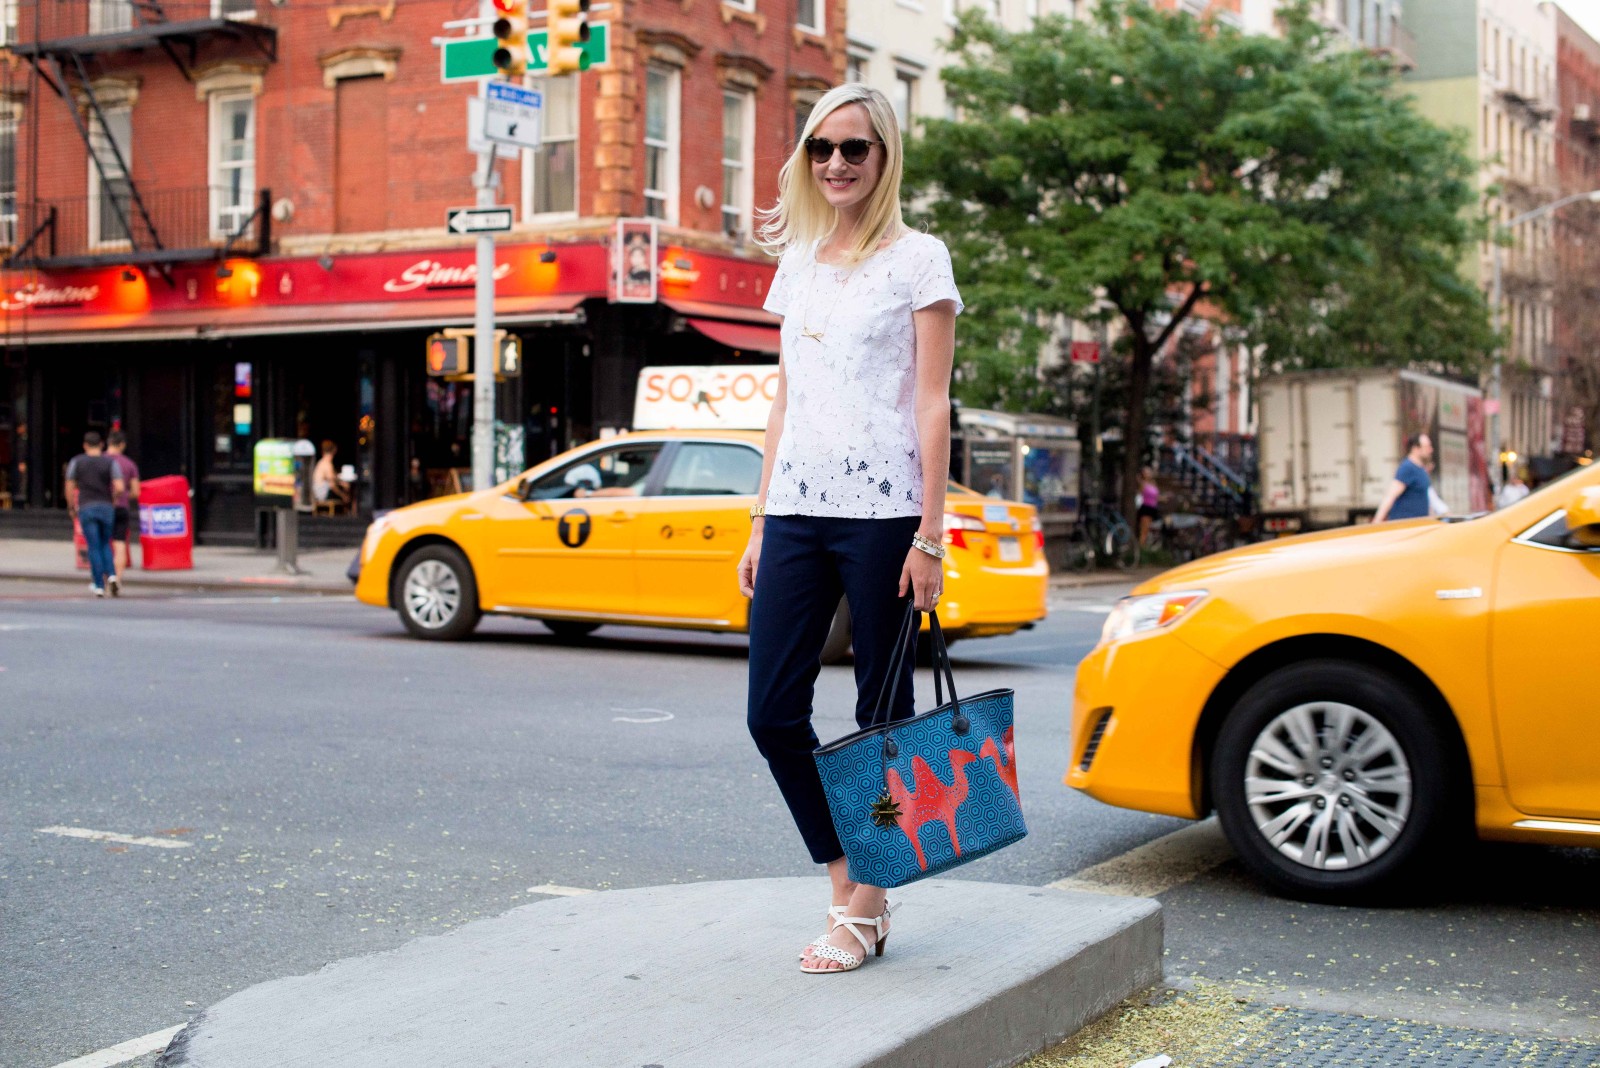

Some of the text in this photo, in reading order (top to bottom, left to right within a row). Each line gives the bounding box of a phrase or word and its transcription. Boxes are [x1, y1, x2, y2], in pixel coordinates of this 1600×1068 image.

[383, 259, 511, 293] Simoe
[645, 373, 693, 403] SO
[563, 513, 588, 545] T
